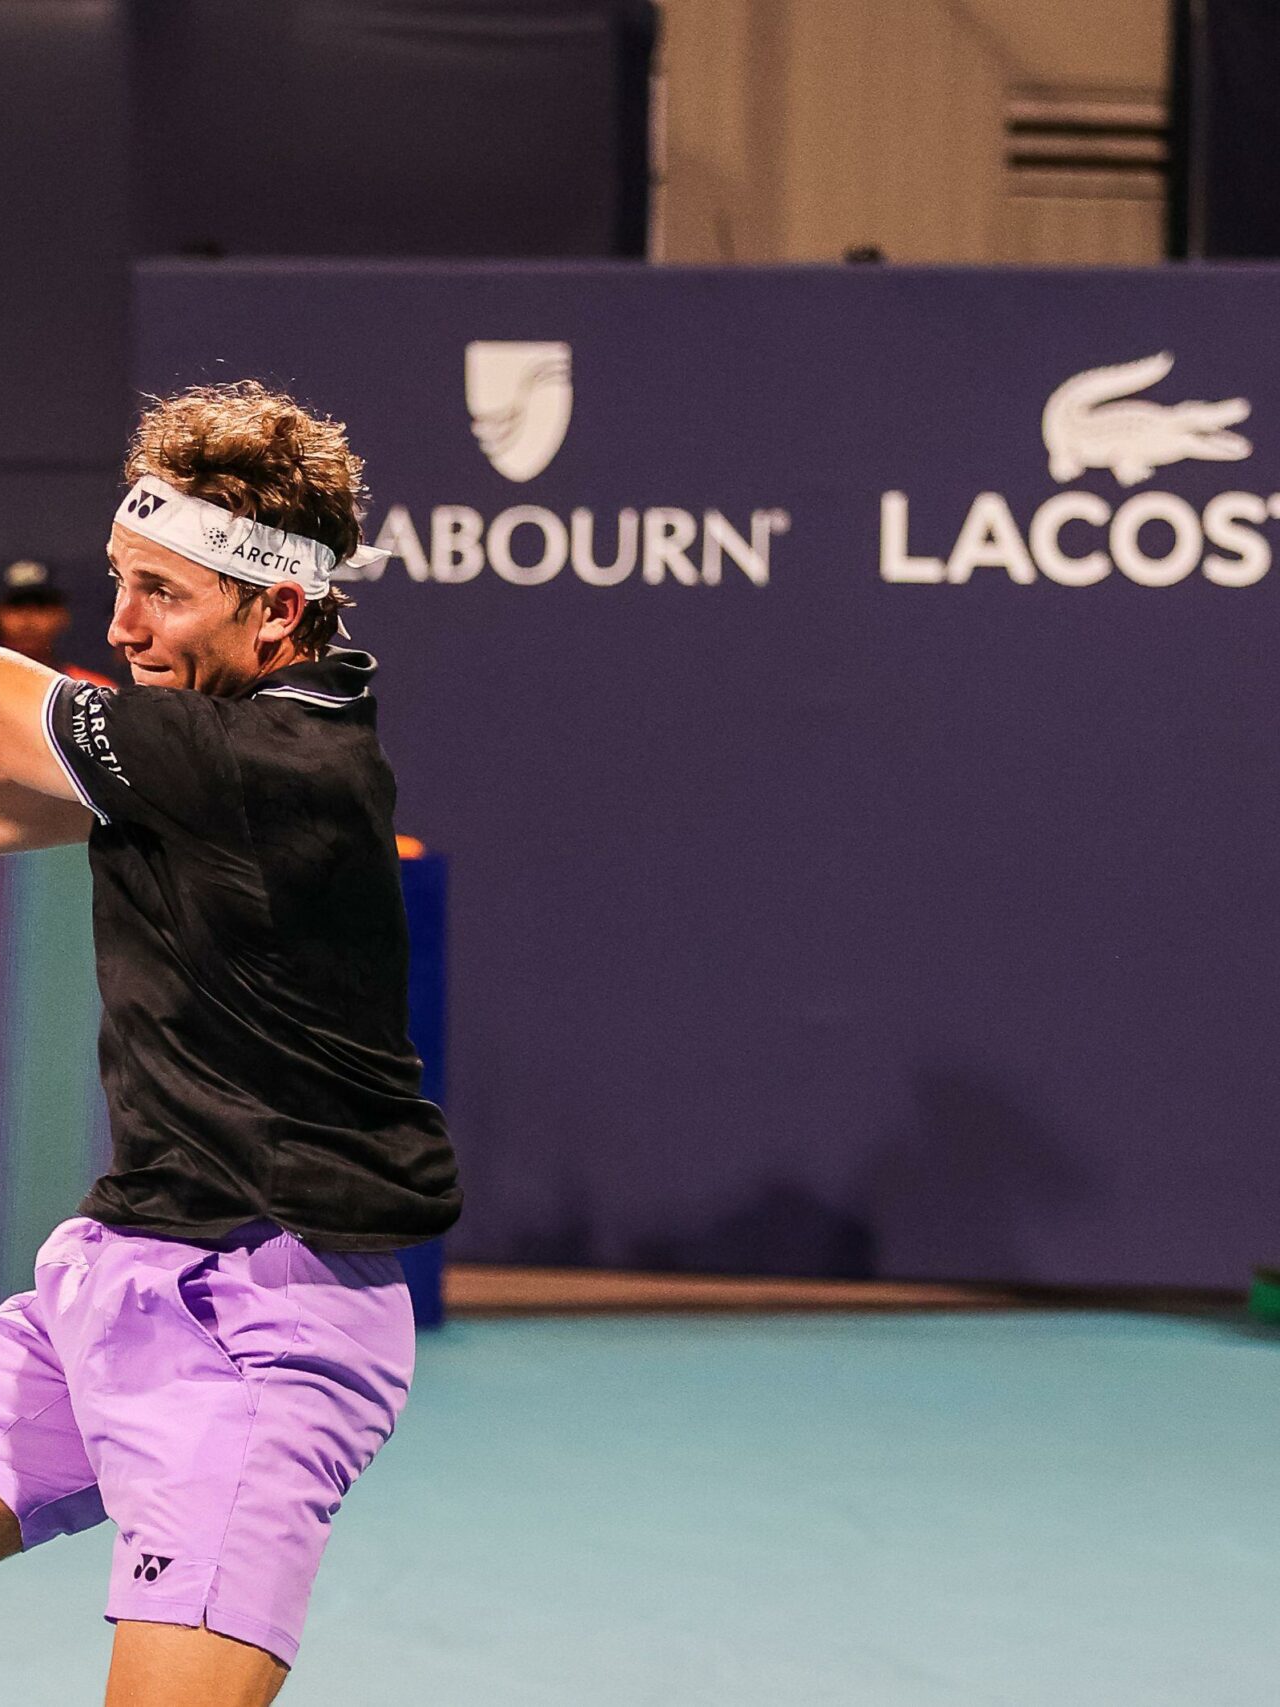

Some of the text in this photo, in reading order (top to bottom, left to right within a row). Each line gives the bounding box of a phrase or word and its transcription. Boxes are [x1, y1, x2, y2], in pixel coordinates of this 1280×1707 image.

[232, 543, 302, 575] ARCTIC
[330, 504, 770, 587] ABOURN
[879, 489, 1280, 588] LACOS
[72, 710, 95, 758] YONE
